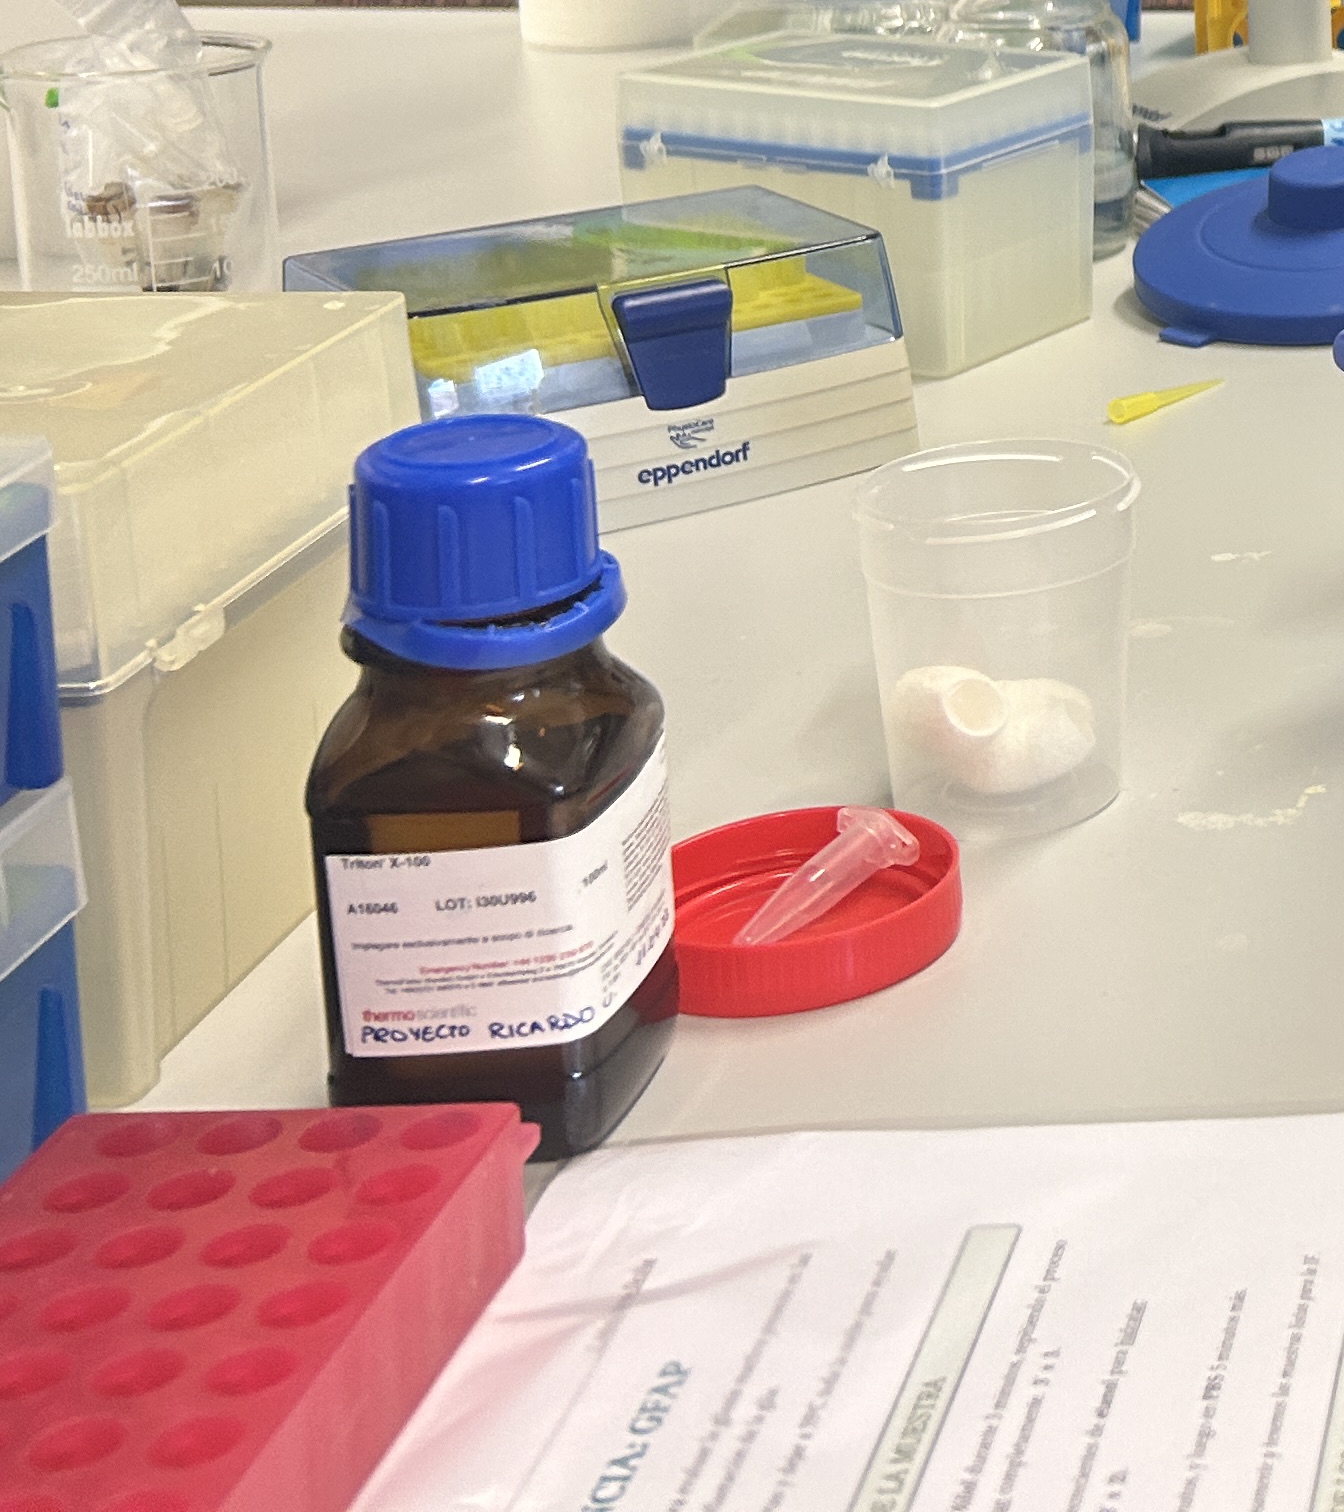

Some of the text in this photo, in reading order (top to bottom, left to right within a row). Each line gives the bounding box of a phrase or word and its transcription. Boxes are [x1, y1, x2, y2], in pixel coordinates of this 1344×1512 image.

[73, 263, 139, 284] 250ml
[637, 440, 751, 487] eppendorf
[435, 897, 472, 912] LOT:
[361, 1006, 596, 1044] PROYECTO RICARDO
[629, 1361, 690, 1434] GFAP
[890, 1377, 946, 1464] MUESTRA
